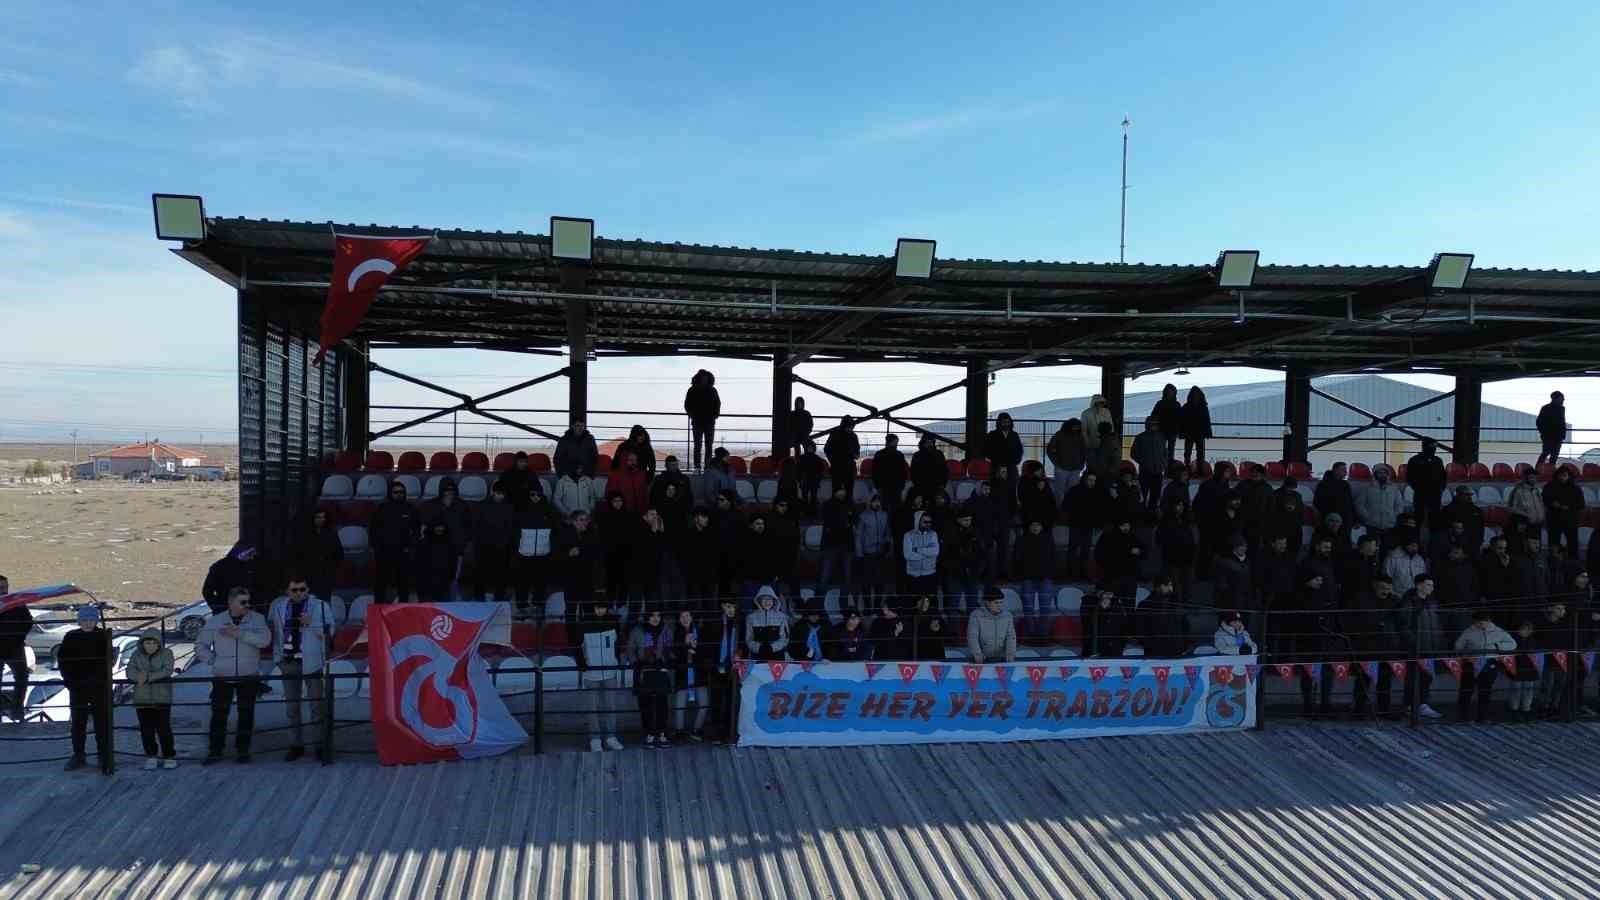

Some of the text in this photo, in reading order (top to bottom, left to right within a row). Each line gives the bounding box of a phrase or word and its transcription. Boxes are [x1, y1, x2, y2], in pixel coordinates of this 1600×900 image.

[767, 684, 1191, 720] BİZE HER YER TRABZON!
